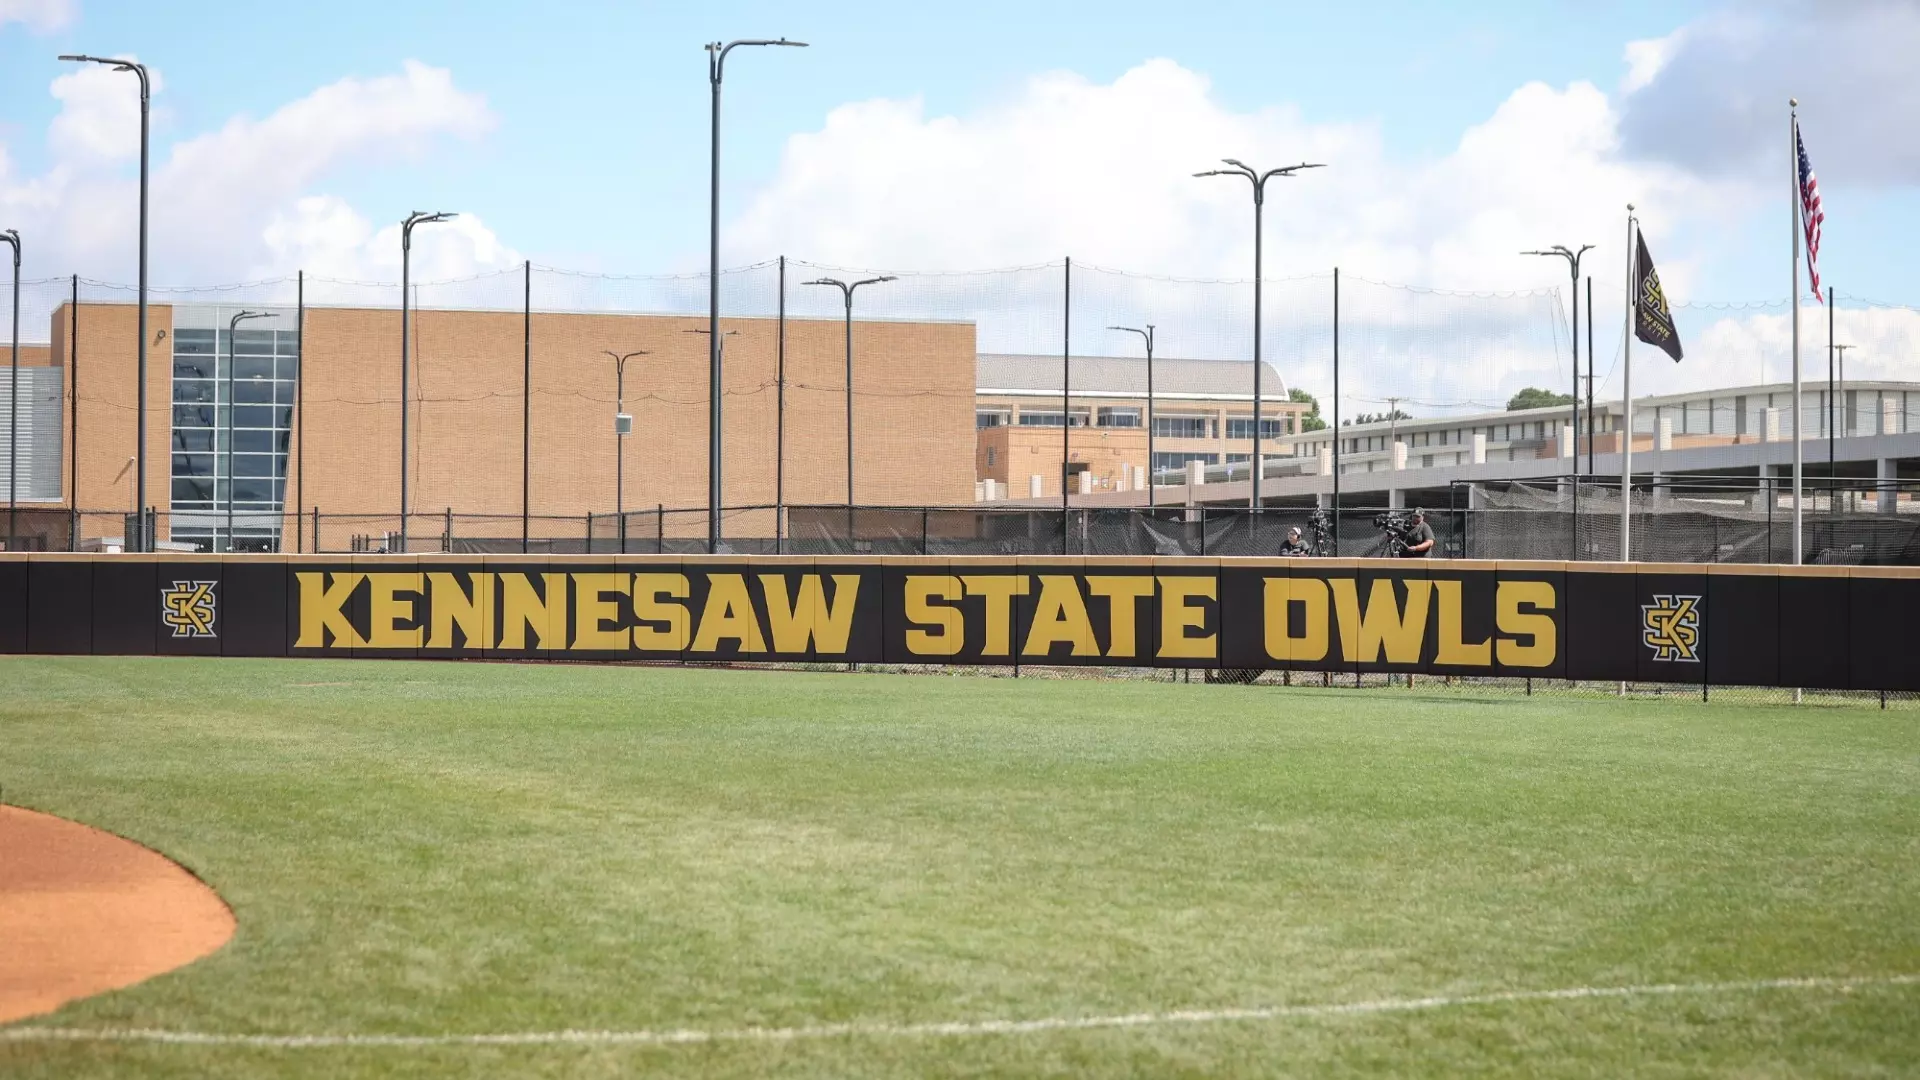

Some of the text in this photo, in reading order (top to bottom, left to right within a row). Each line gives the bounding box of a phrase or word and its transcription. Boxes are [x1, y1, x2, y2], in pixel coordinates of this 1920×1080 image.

[1652, 320, 1670, 338] STATE
[295, 572, 1557, 668] KENNESAW STATE OWLS
